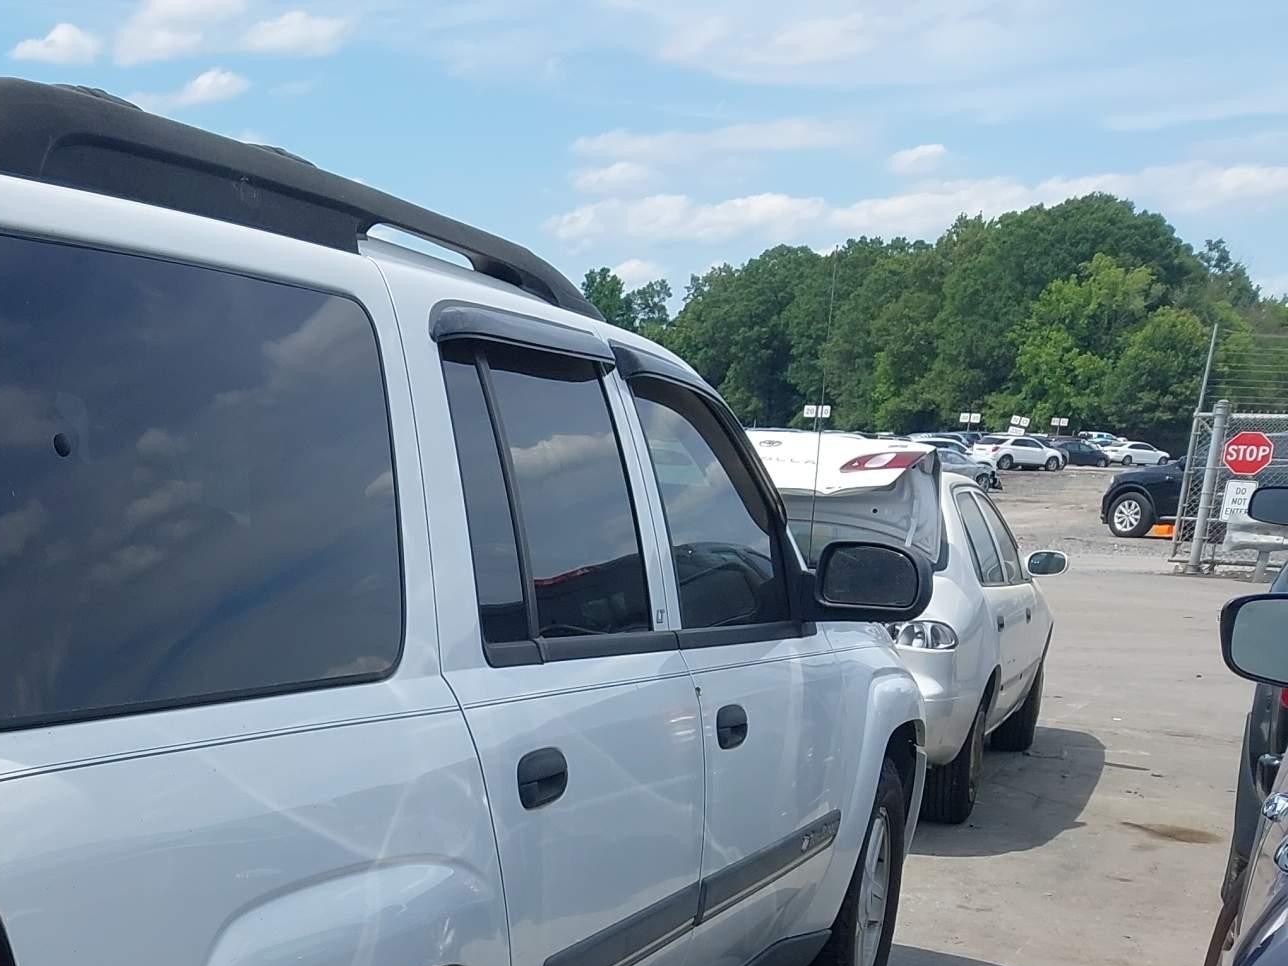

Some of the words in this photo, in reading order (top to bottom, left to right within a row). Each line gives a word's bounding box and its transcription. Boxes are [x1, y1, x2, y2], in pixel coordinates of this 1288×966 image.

[1226, 445, 1270, 461] STOP
[1235, 487, 1247, 495] DO
[1231, 497, 1248, 506] NOT
